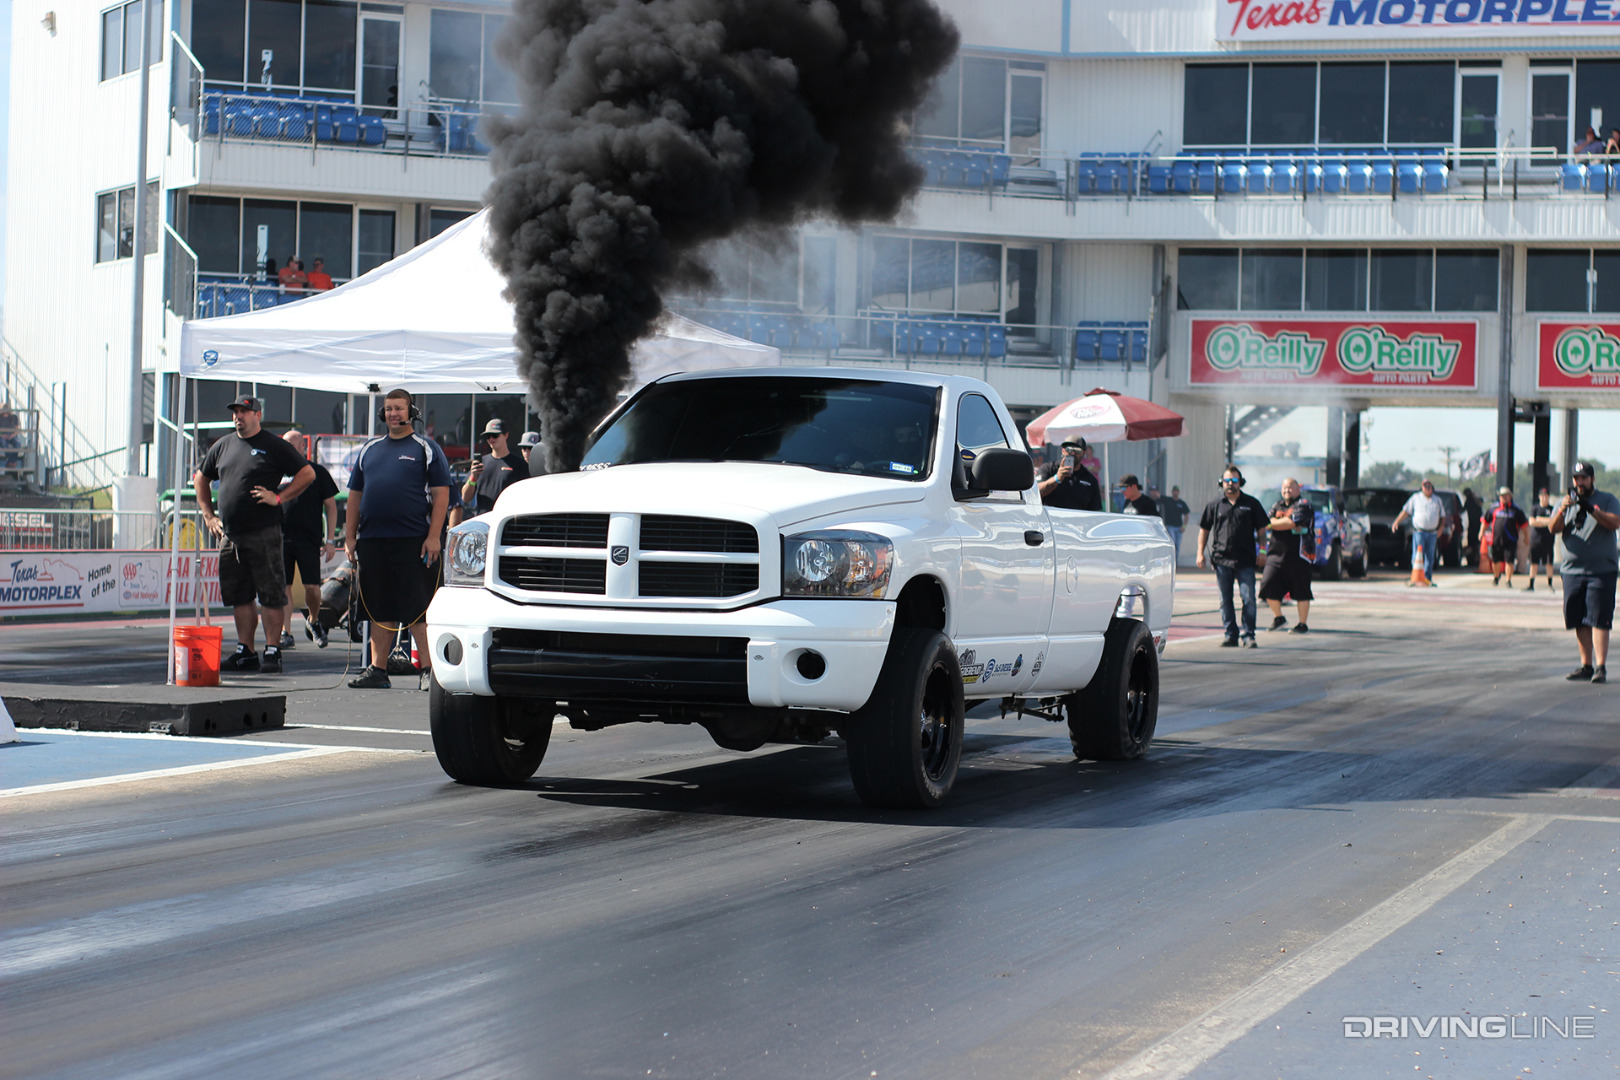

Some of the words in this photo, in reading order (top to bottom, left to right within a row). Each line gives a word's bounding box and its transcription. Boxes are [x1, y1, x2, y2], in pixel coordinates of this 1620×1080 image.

[1227, 0, 1326, 36] Texas
[1328, 0, 1620, 26] MOTORPLE
[1211, 329, 1319, 371] O'Reilly
[1343, 331, 1453, 373] O'Reilly
[1372, 373, 1397, 384] AUTO
[1399, 373, 1428, 384] PARTS
[1590, 375, 1617, 386] AUTO
[10, 559, 39, 585] Texas
[88, 564, 112, 582] Home
[0, 585, 82, 602] MOTORPLEX
[91, 583, 101, 598] of
[102, 578, 116, 593] the
